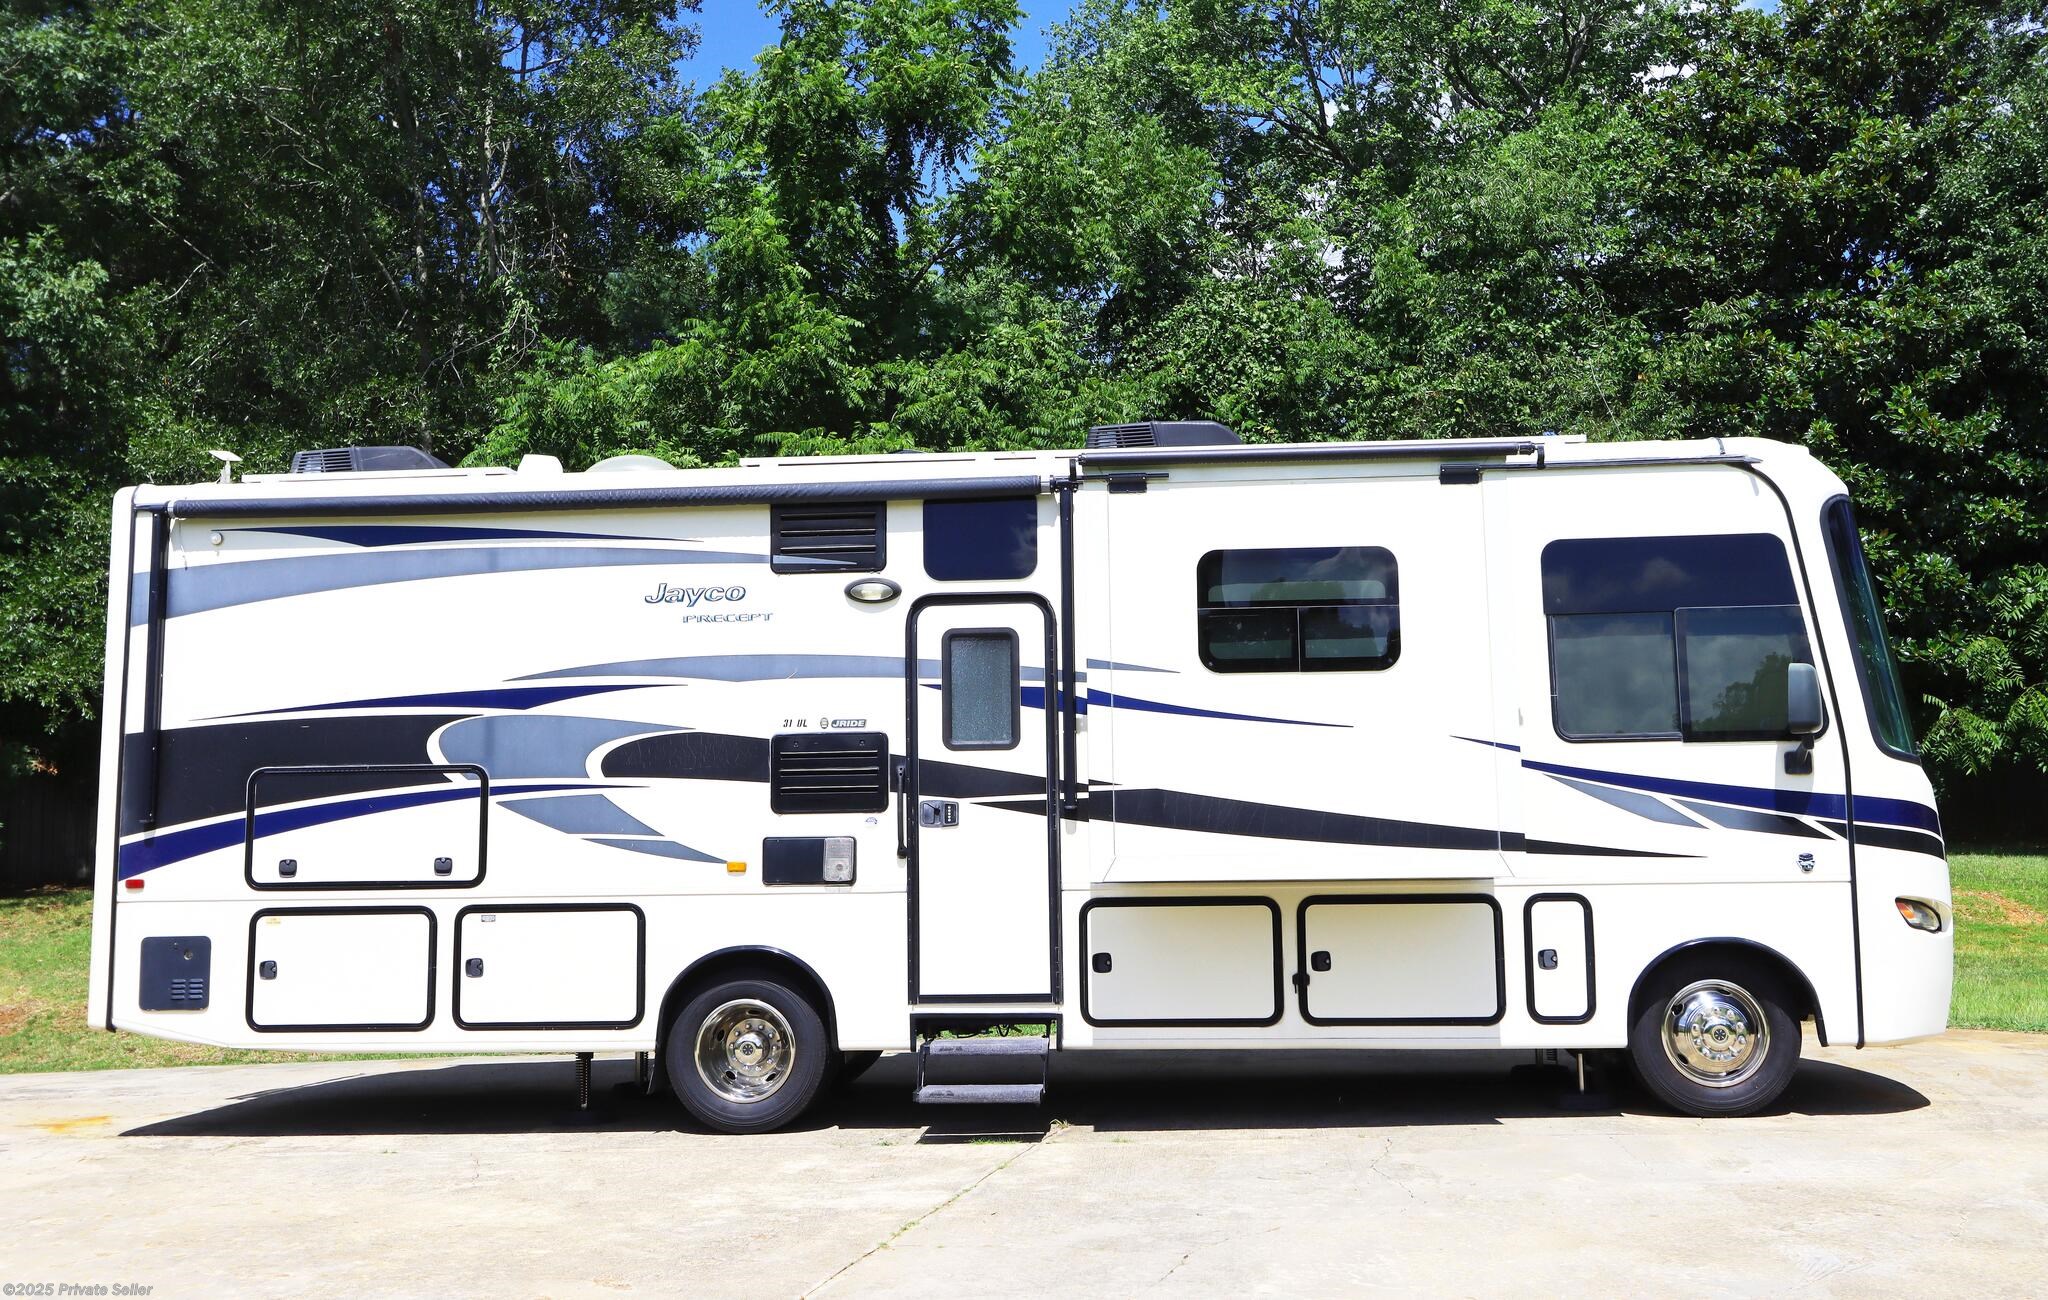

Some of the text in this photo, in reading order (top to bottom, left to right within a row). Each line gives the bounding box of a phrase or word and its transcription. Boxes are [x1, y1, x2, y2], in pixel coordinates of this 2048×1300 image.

[645, 583, 746, 607] Jayco
[683, 613, 774, 624] PRECEPT
[783, 719, 793, 728] 31
[832, 719, 866, 728] JRIDE
